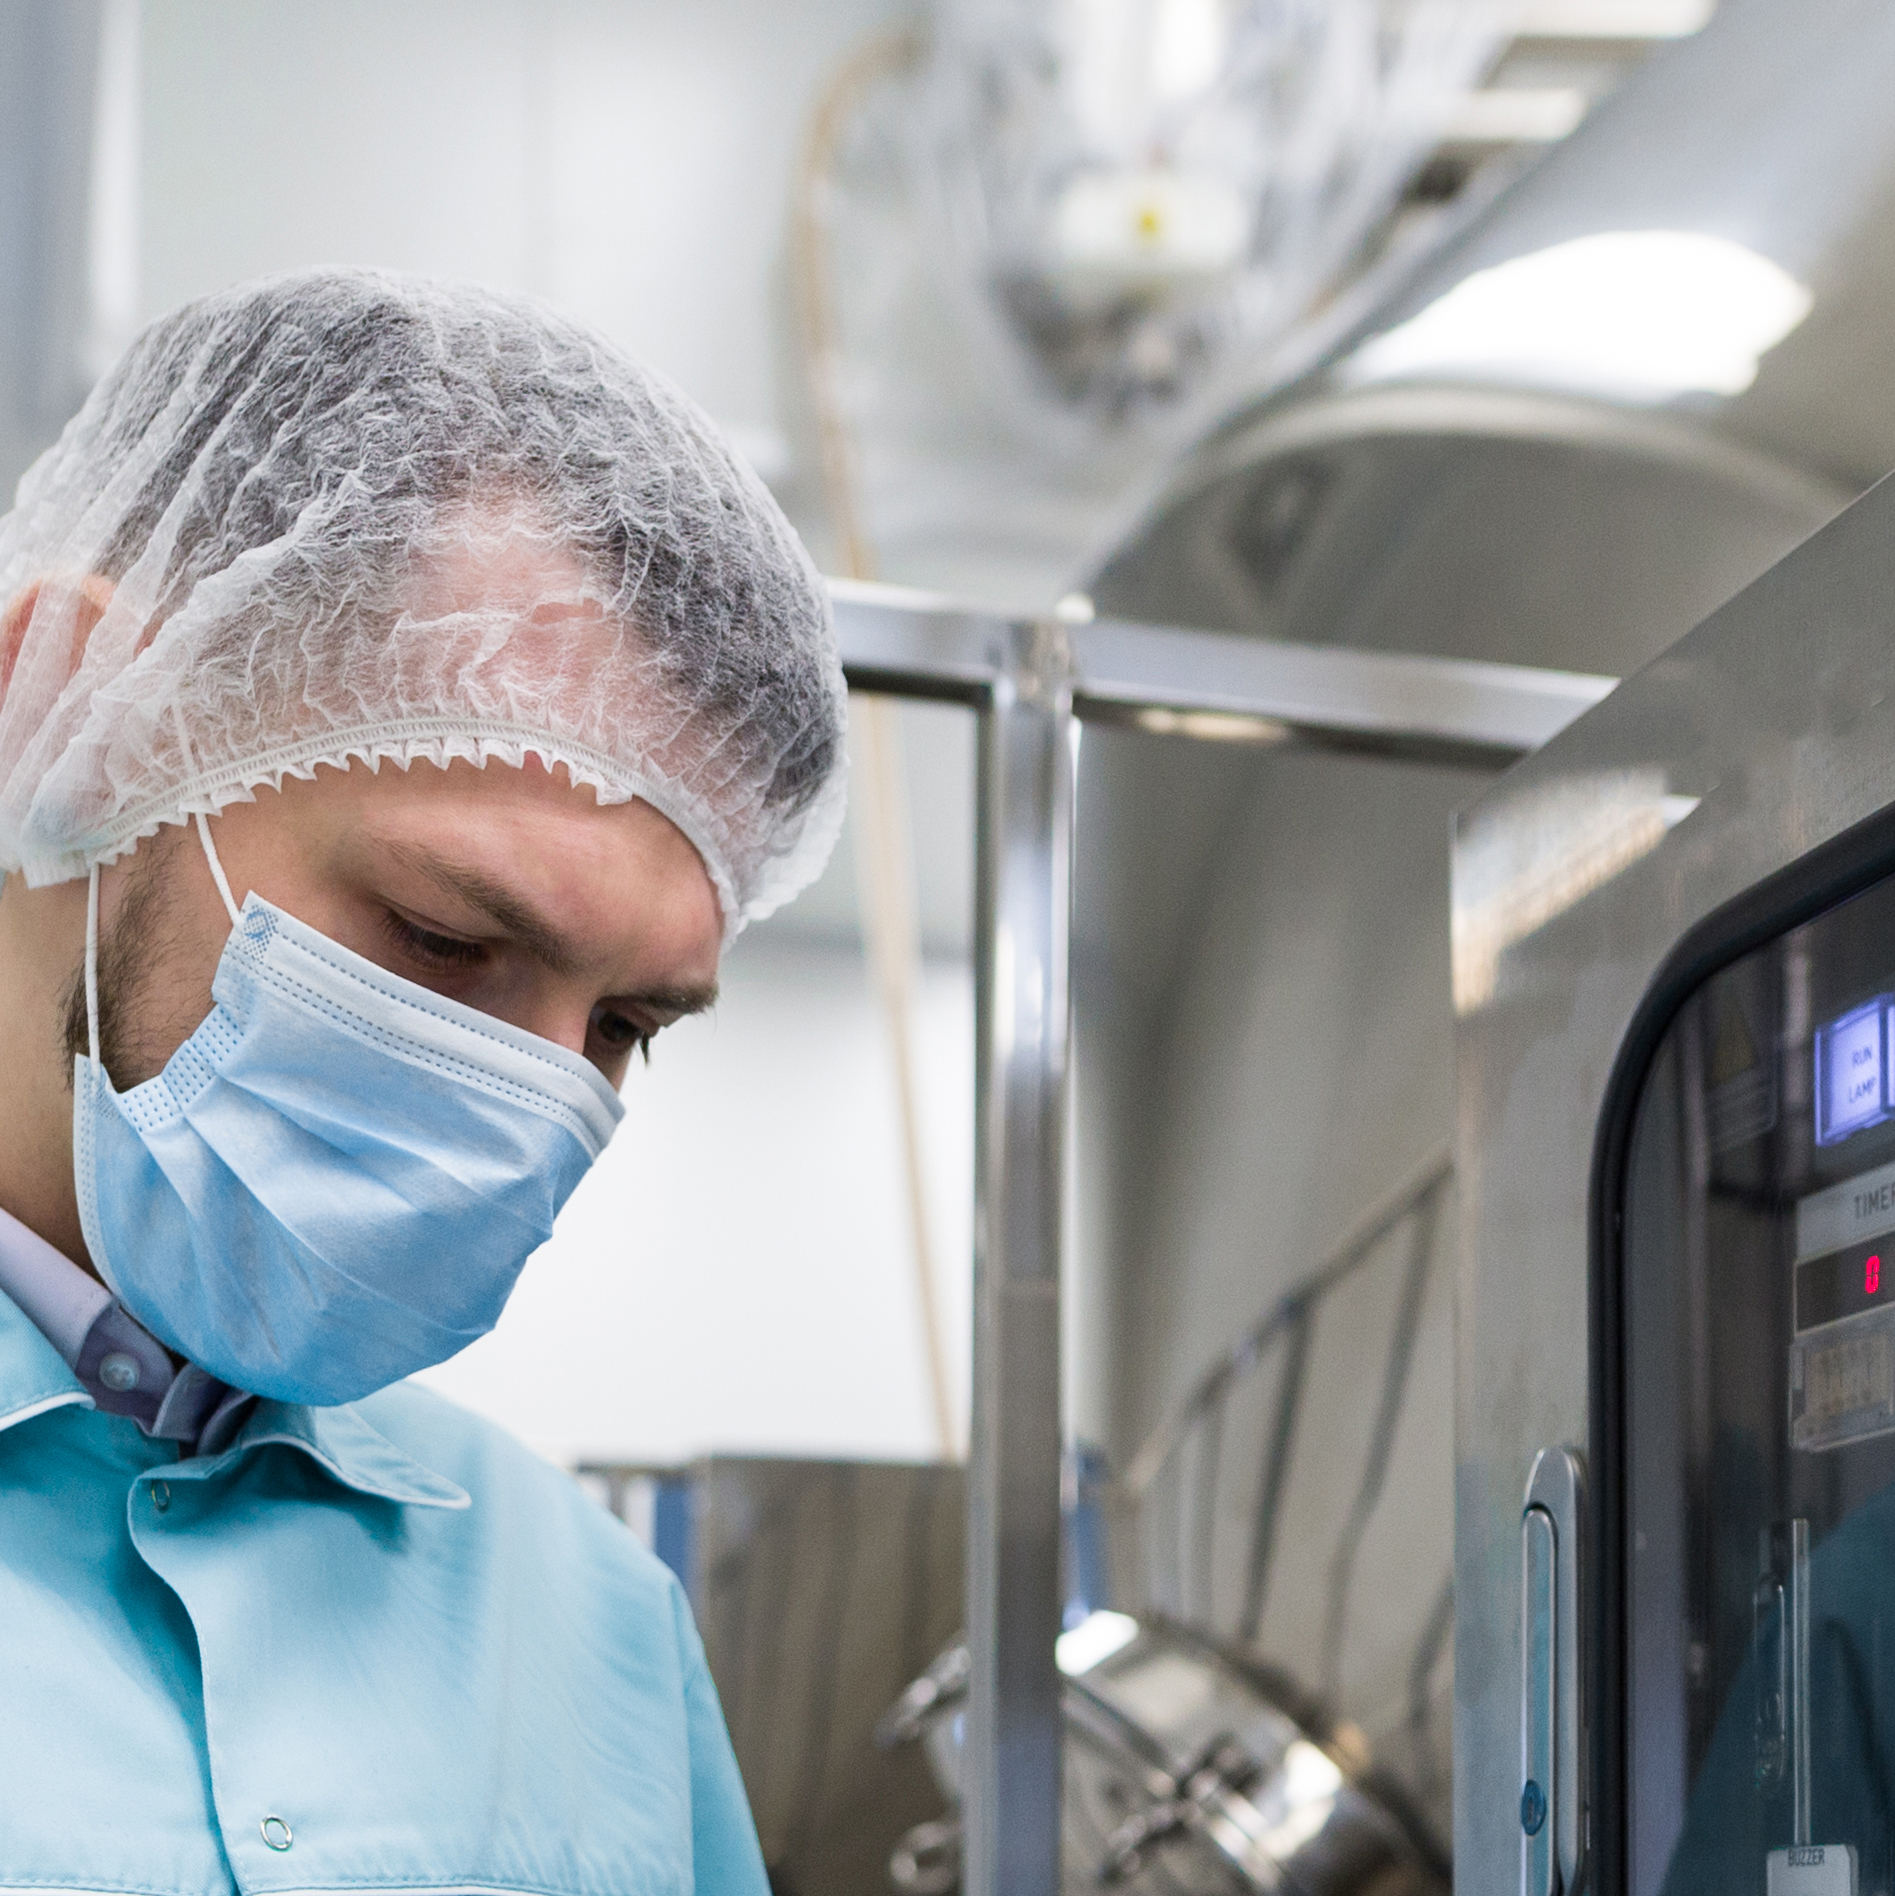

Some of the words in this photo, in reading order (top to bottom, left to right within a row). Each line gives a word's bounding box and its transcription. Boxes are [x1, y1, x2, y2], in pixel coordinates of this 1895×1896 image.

[1852, 1046, 1872, 1068] RUN
[1849, 1077, 1875, 1103] LAMP
[1865, 1254, 1880, 1295] 0
[1787, 1848, 1825, 1867] BUZZER
